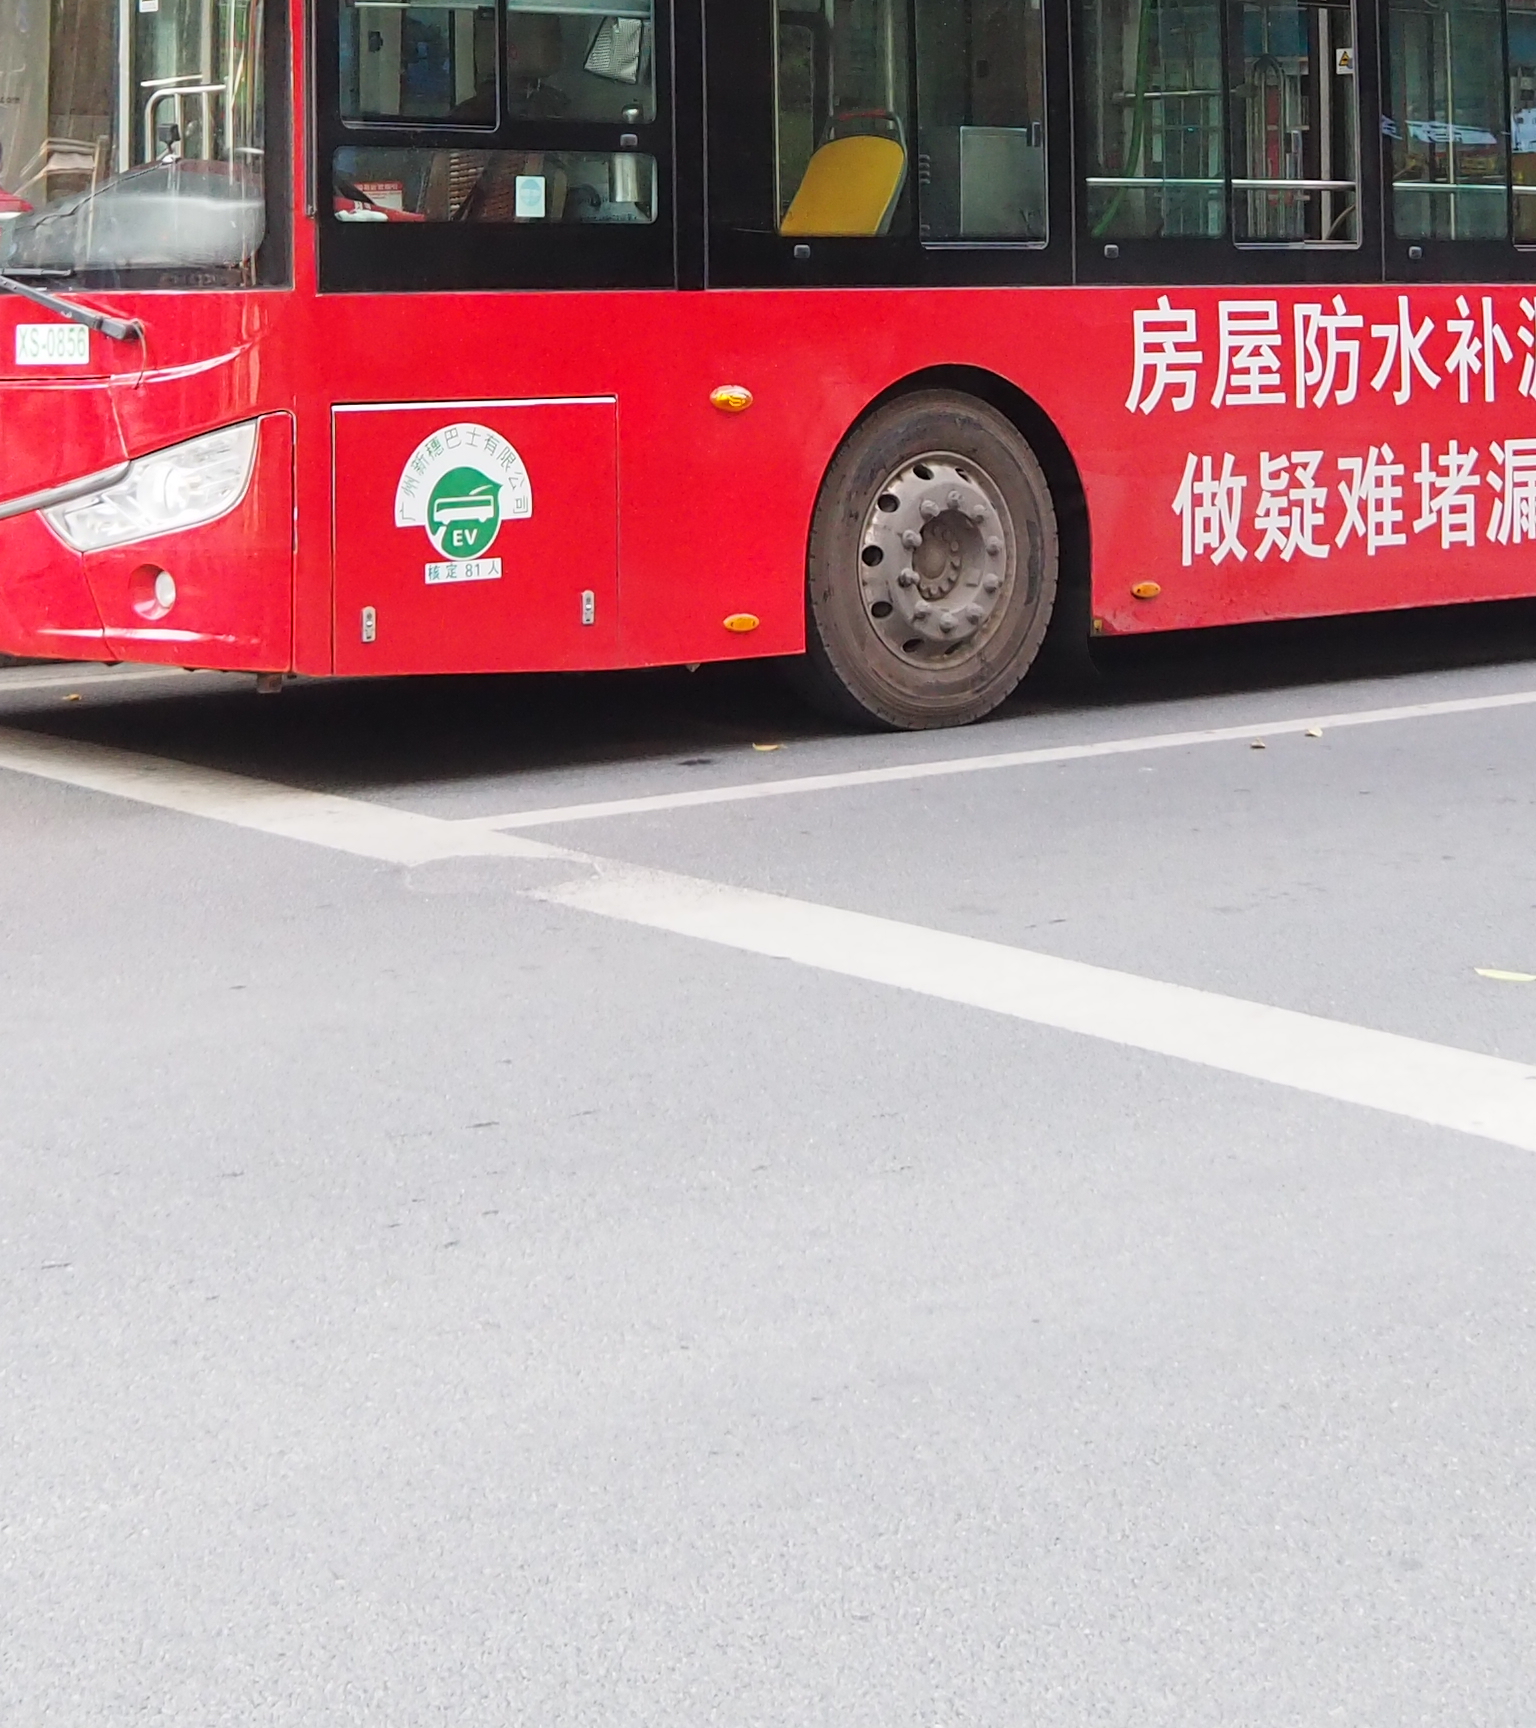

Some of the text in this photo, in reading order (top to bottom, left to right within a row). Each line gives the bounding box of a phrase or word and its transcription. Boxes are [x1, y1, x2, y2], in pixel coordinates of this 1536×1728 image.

[18, 326, 87, 359] XS-0856
[398, 426, 531, 523] 广州新穗巴士有限公司
[451, 528, 479, 547] EV
